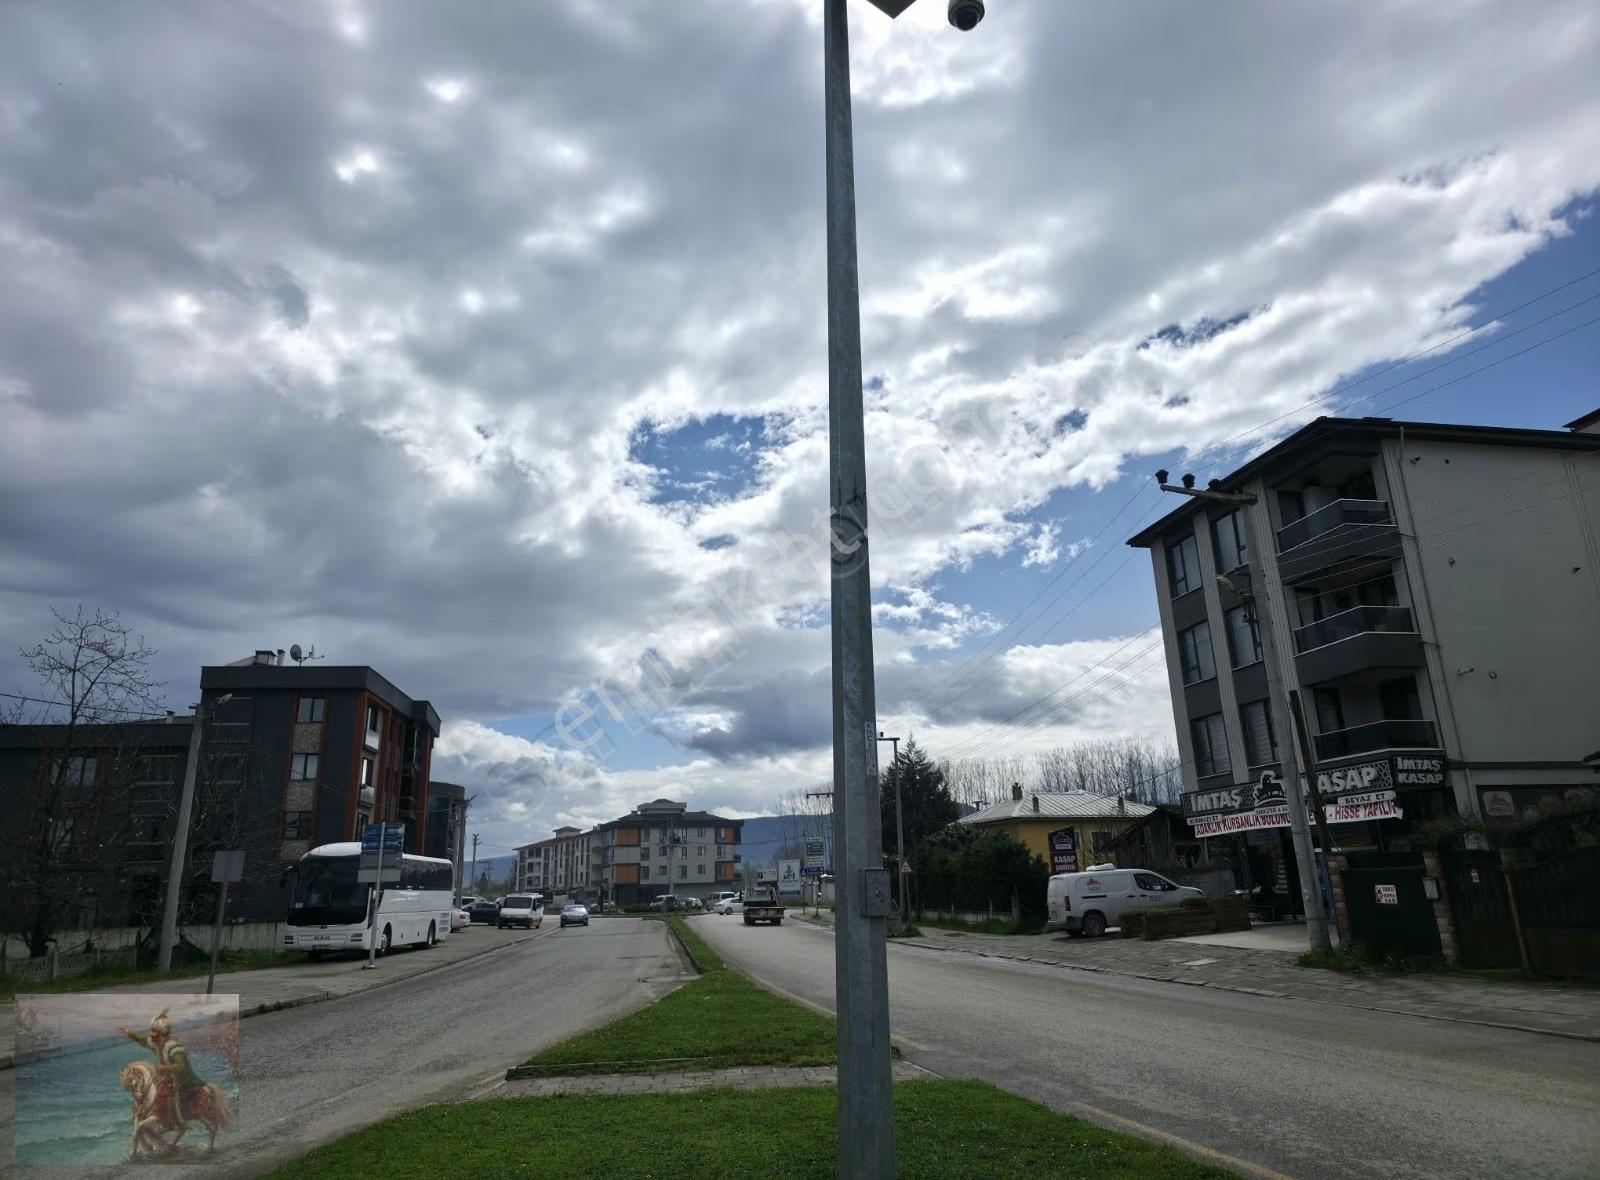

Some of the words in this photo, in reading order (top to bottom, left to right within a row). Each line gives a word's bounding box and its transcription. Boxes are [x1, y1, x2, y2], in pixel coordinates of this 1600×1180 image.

[1398, 773, 1444, 784] KASAP
[1345, 796, 1371, 804] BEYAZ
[1222, 815, 1263, 831] KURBANLIK
[1053, 855, 1076, 863] KASAP
